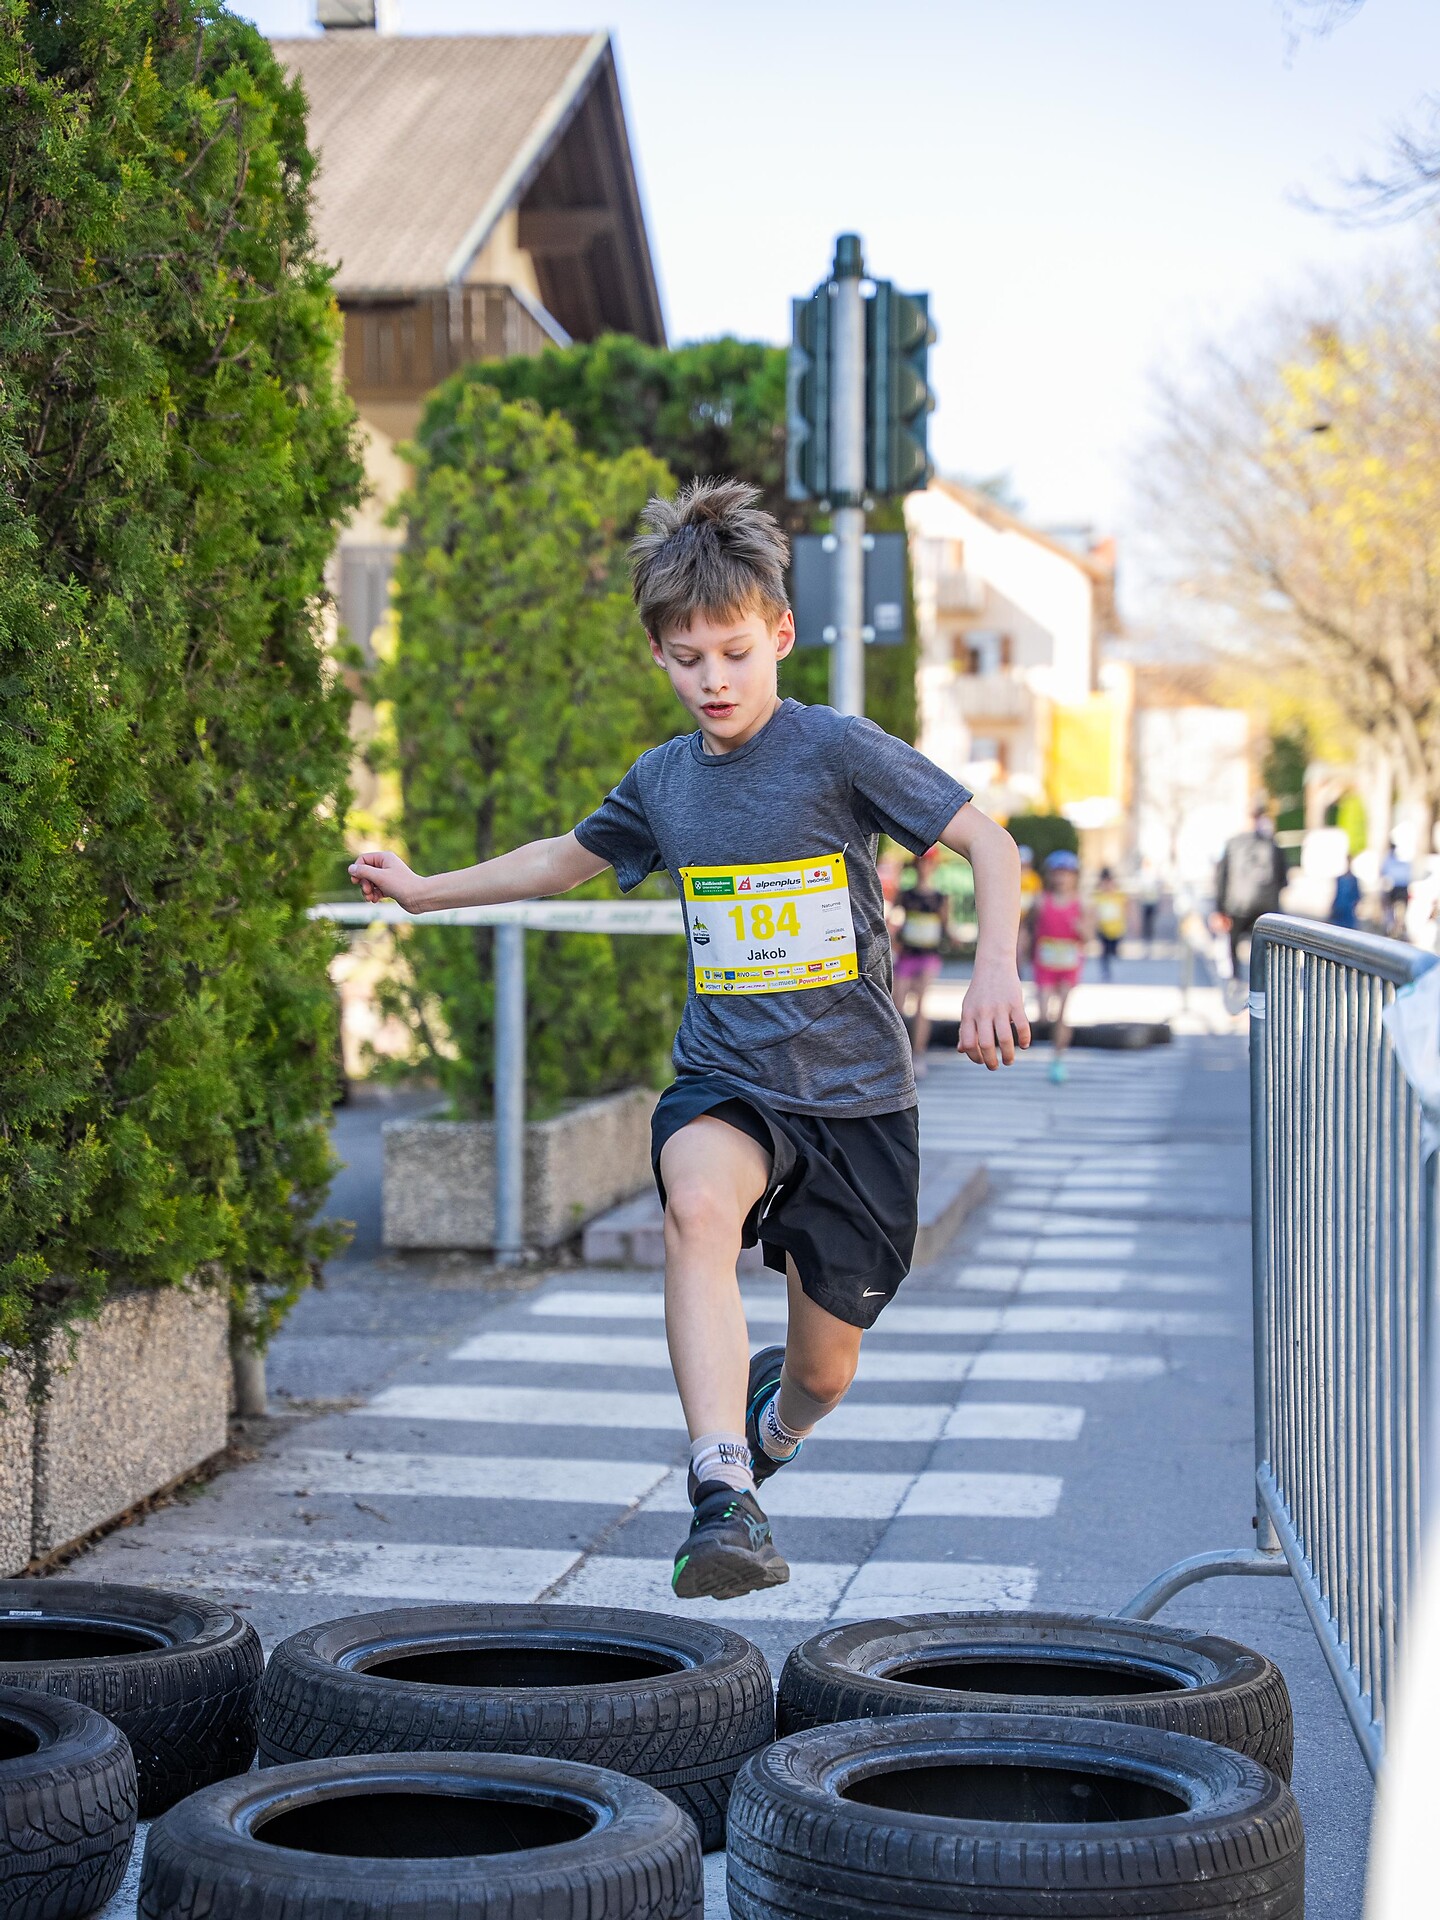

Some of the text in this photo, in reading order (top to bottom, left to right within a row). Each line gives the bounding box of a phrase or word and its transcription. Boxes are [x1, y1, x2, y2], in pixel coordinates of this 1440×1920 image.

[755, 877, 802, 889] alpenplus
[727, 901, 802, 942] 184
[747, 947, 787, 961] Jakob
[798, 975, 829, 985] Powerbar
